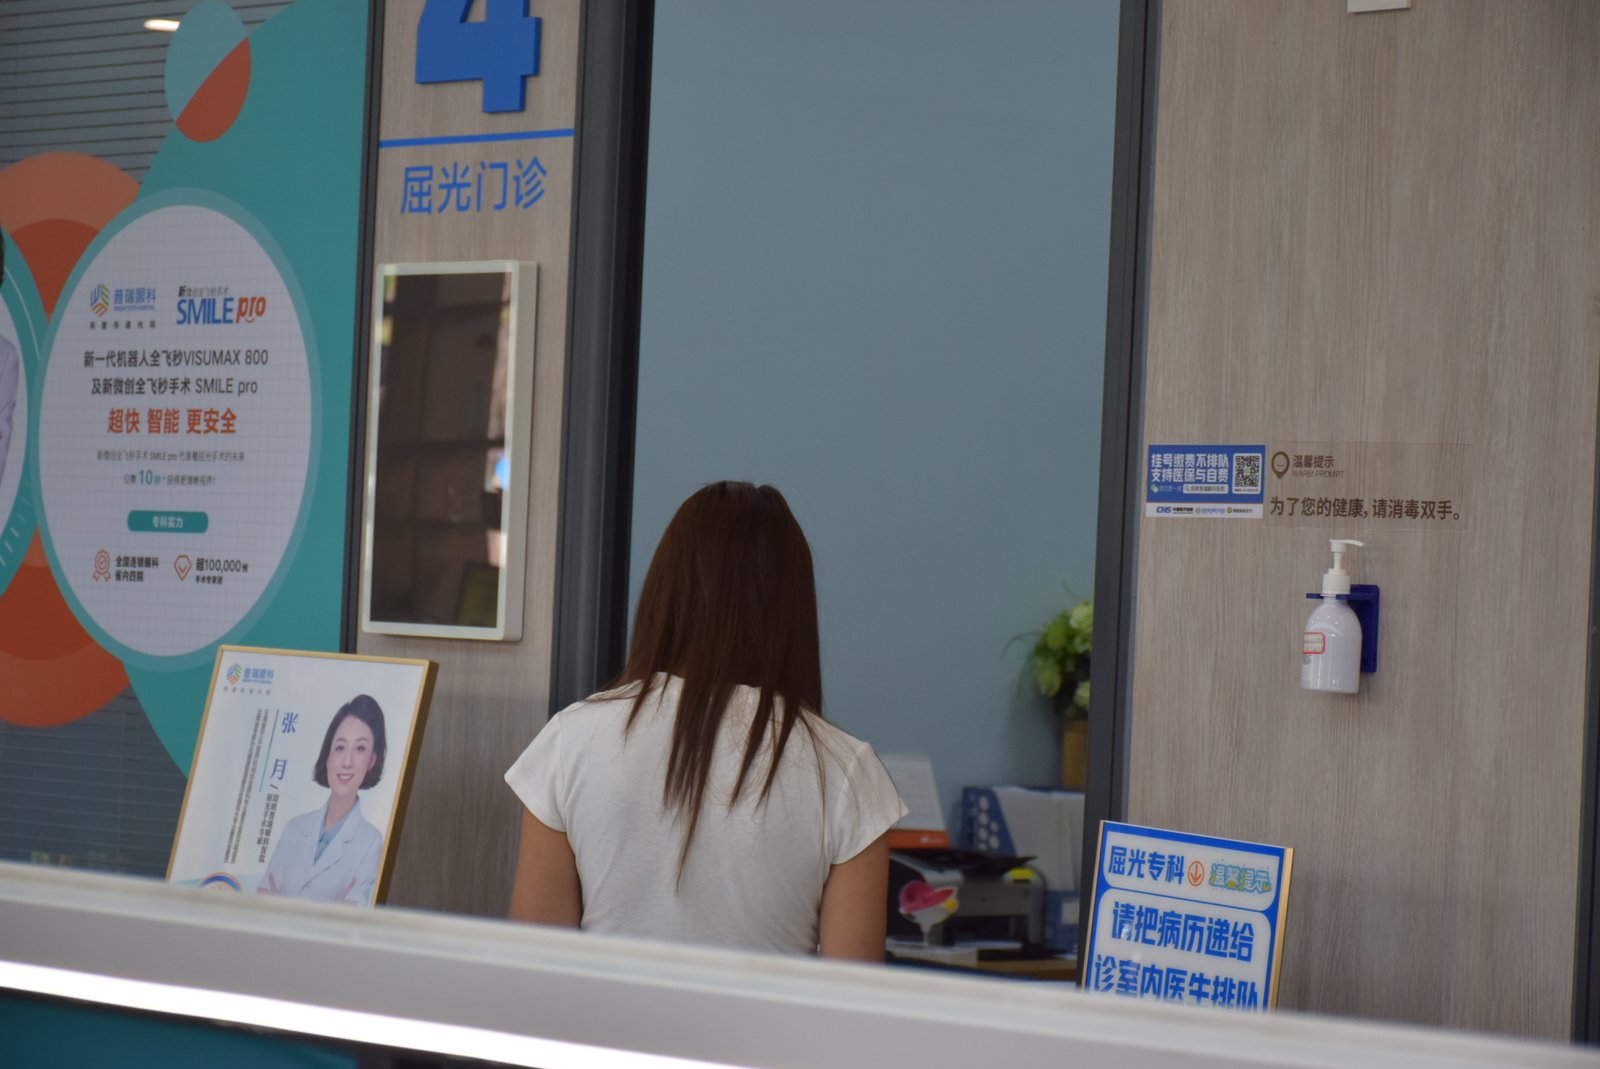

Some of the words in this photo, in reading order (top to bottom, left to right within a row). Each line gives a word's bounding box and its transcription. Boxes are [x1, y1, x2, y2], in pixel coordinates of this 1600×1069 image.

[415, 0, 541, 114] 4
[400, 156, 548, 215] 屈光门诊
[113, 287, 157, 304] 普瑞眼科
[176, 297, 234, 325] SMILE
[235, 295, 267, 324] pro
[83, 349, 241, 369] 新一代机器人全飞秒VISUMAX
[244, 349, 270, 366] 800
[90, 378, 191, 396] 及新微创全飞秒手术
[195, 379, 234, 394] SMILE
[237, 381, 259, 397] pro
[107, 407, 140, 434] 超快
[146, 407, 180, 434] 智能
[186, 407, 238, 434] 更安全
[1151, 453, 1229, 468] 挂号缴费不排队
[1292, 454, 1335, 469] 温馨提示
[1151, 468, 1229, 483] 支持医保与自费
[1292, 470, 1314, 478] WARM
[1315, 470, 1345, 479] PROMPT
[1107, 845, 1185, 885] 屈光专科
[1208, 862, 1272, 894] 温馨提示
[1111, 901, 1255, 963] 请把病历递给
[1094, 953, 1258, 1009] 诊室内医生排队
